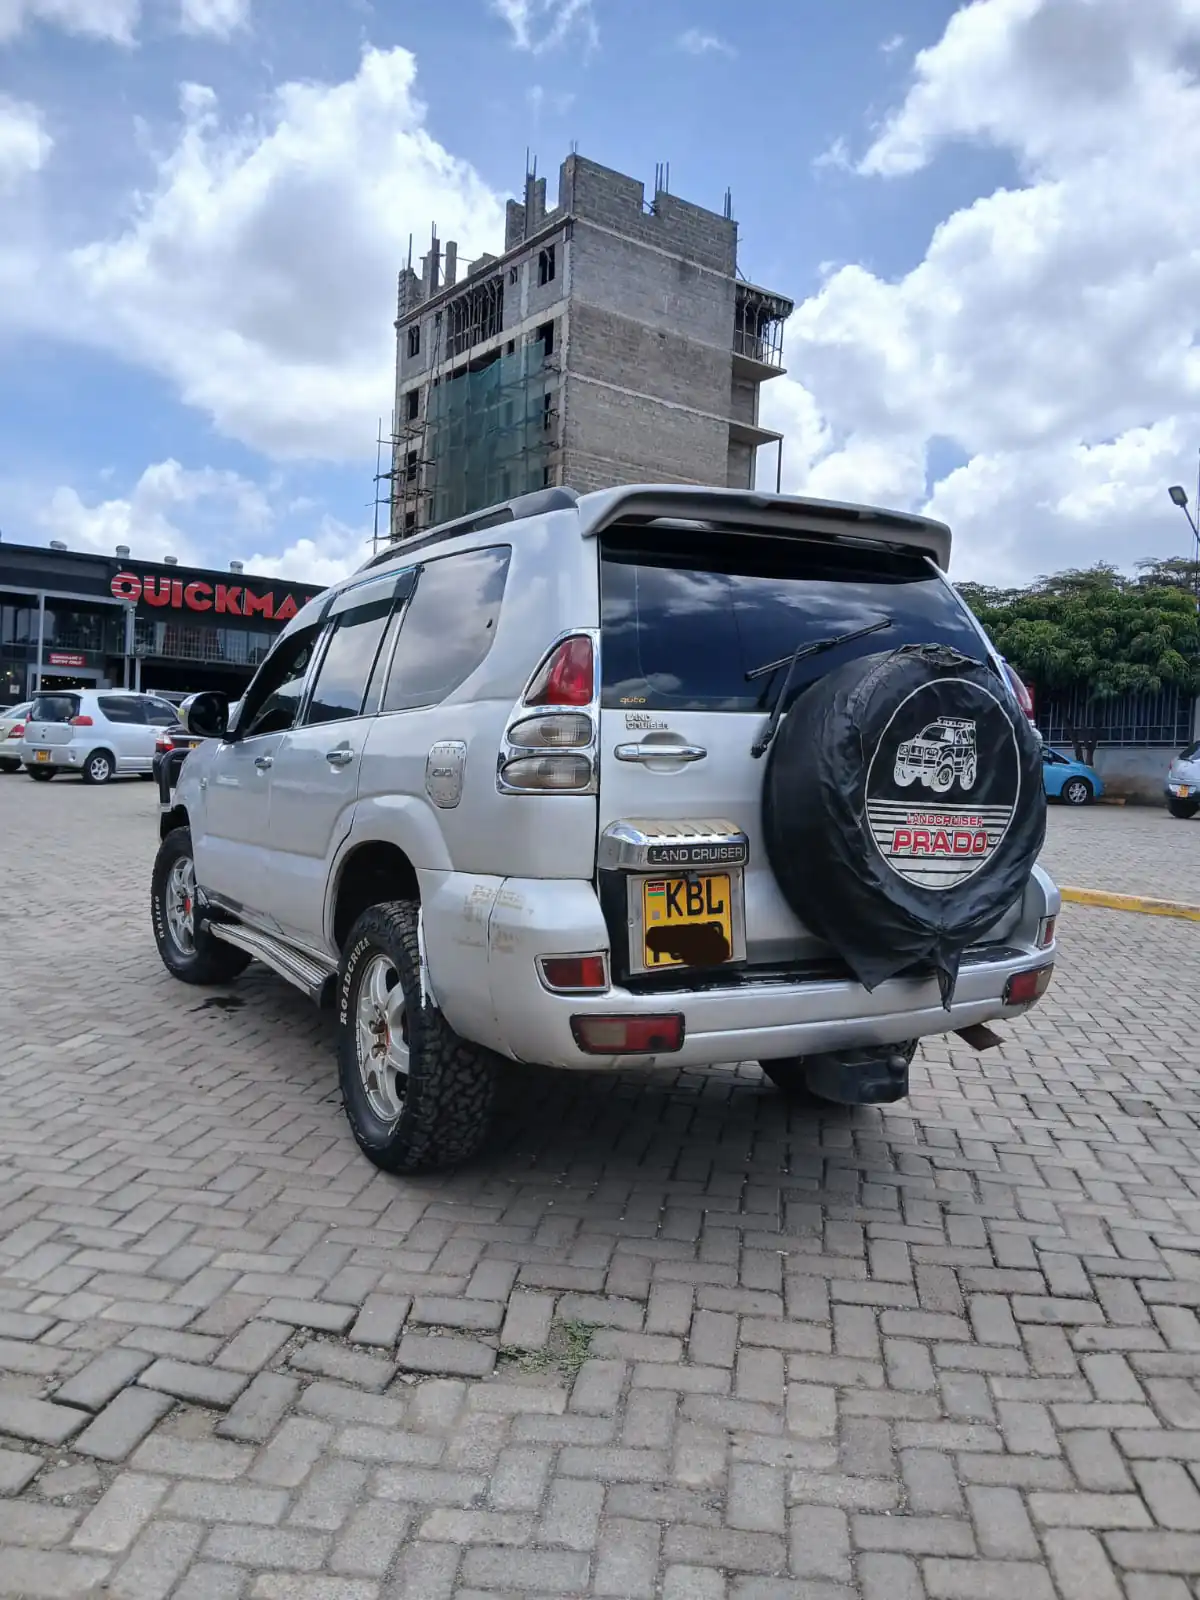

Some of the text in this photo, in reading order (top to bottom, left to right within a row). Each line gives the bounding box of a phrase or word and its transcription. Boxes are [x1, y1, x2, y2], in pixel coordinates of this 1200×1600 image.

[111, 572, 311, 620] QUICKMA
[625, 713, 651, 722] LAND
[653, 846, 743, 861] LAND CRUISER
[892, 829, 987, 855] PRADO
[666, 879, 724, 918] KBL
